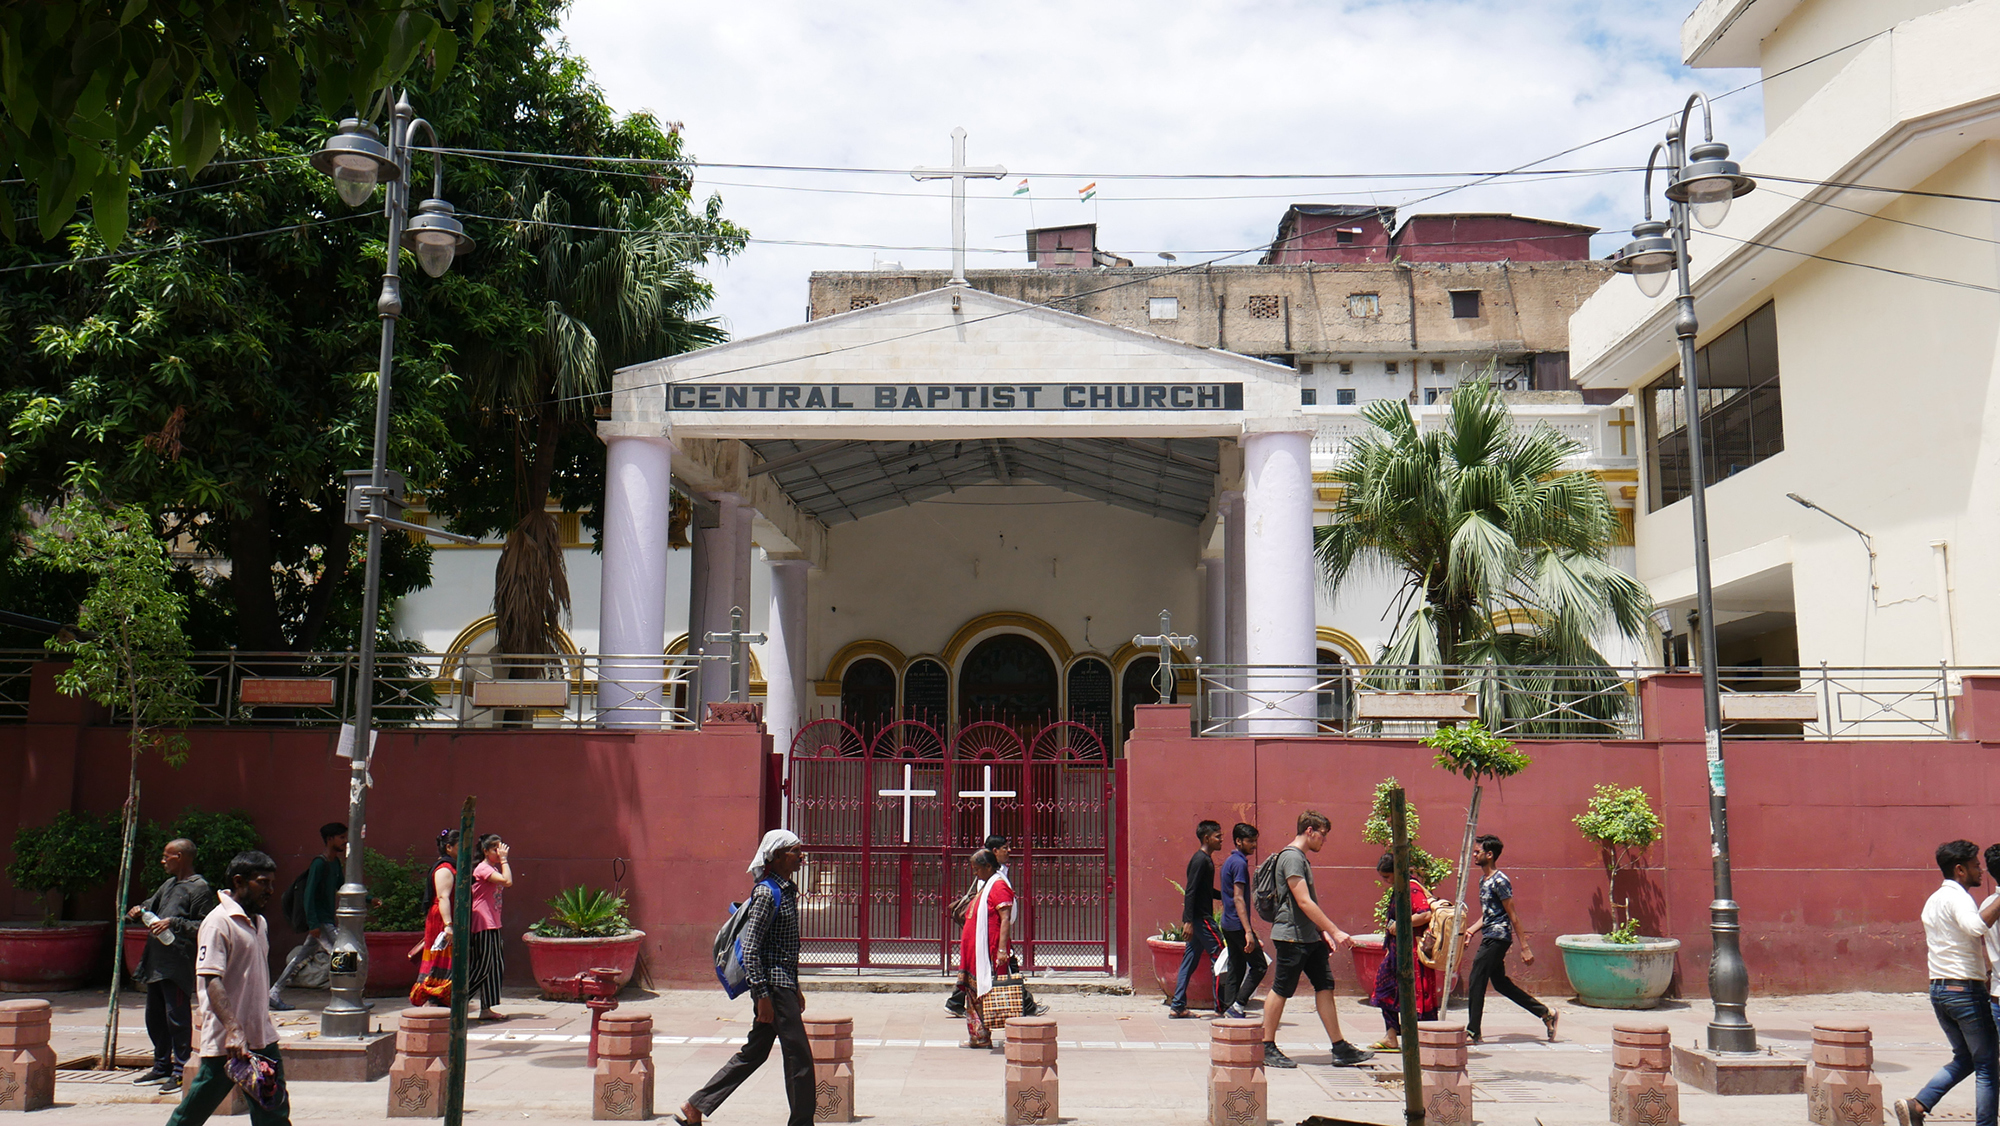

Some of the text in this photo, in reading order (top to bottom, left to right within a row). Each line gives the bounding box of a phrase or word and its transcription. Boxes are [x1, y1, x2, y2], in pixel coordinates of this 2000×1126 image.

[673, 385, 1220, 408] CENTRAL BAPTIST CHURCH
[199, 945, 206, 961] 3
